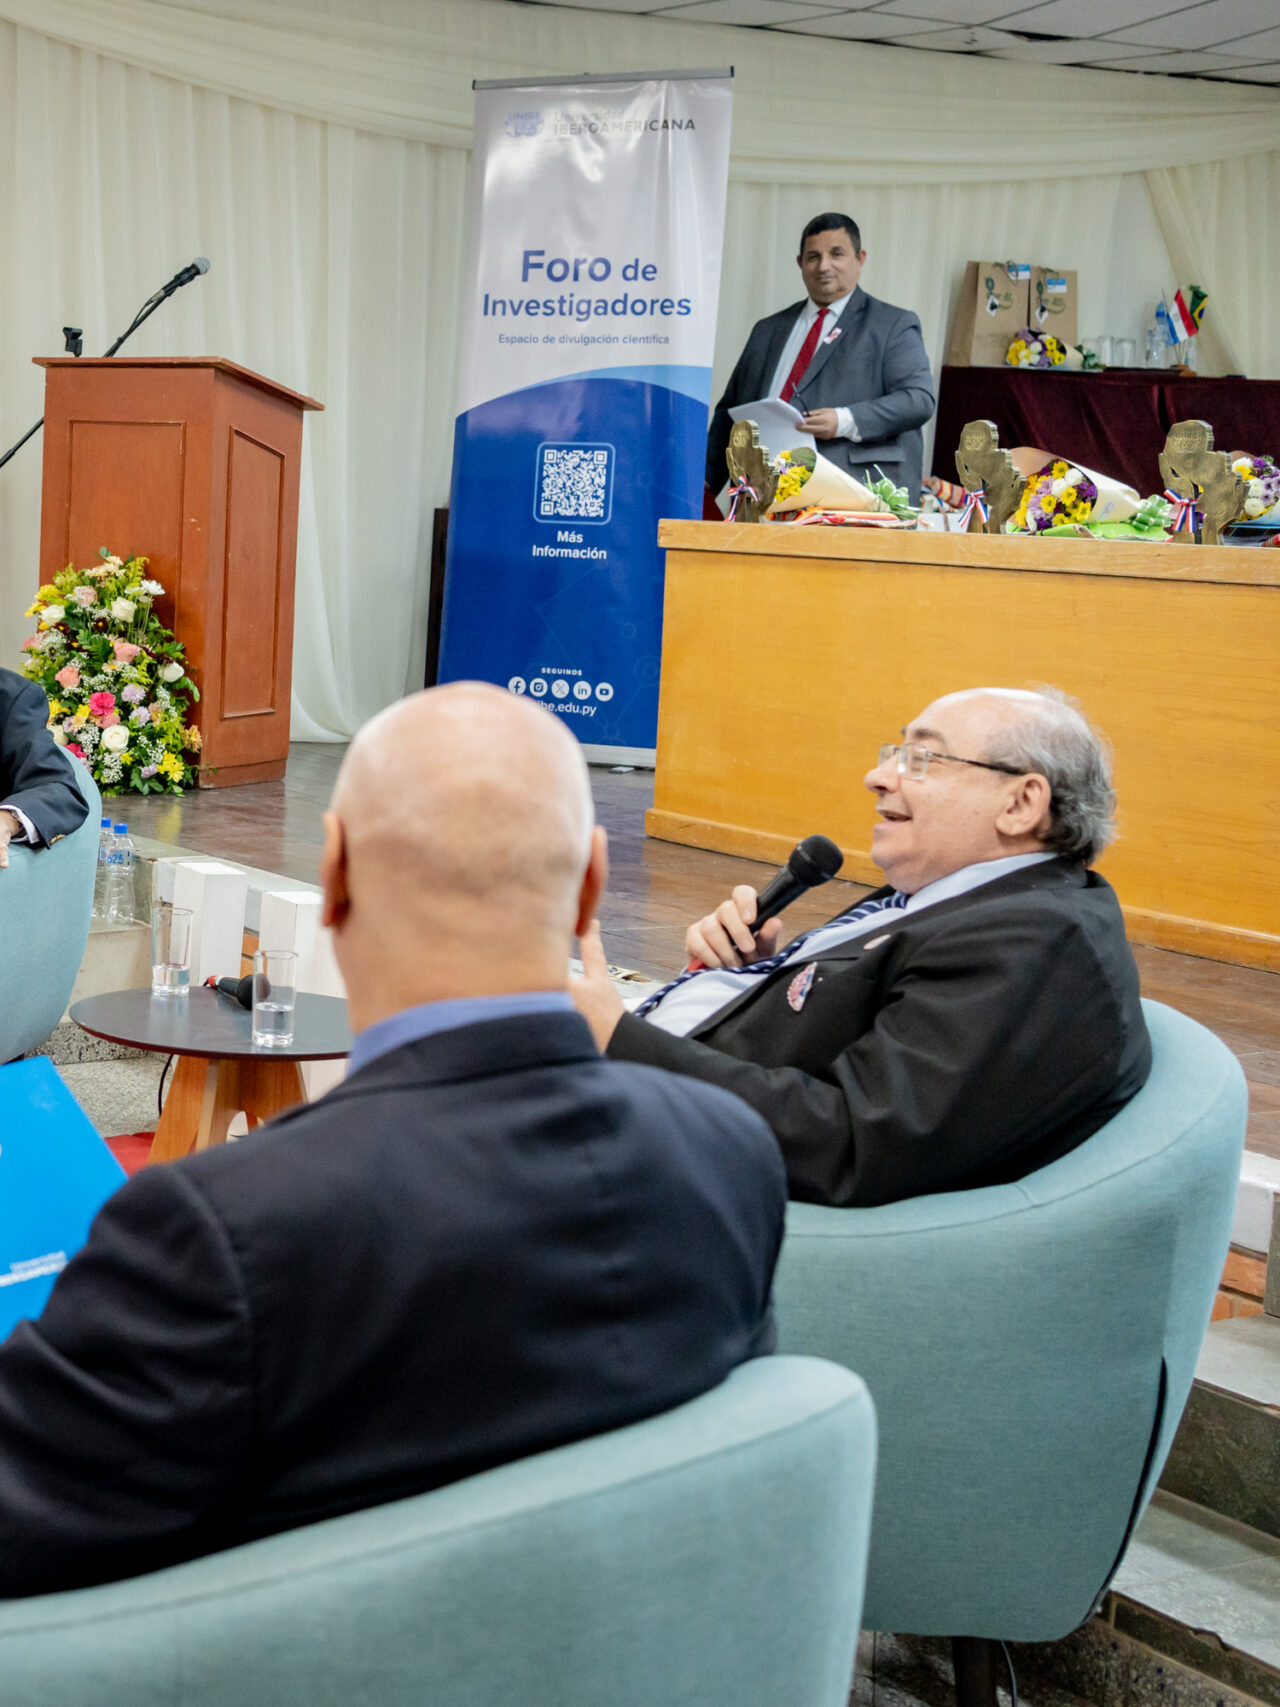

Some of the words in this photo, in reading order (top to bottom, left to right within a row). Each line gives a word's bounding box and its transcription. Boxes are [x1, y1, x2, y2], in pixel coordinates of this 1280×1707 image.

[553, 117, 696, 135] IBEROAMERICANA
[521, 250, 612, 283] Foro
[621, 258, 658, 282] de
[482, 293, 692, 322] Investigadores
[498, 333, 539, 346] Espacio
[542, 333, 556, 344] de
[558, 333, 620, 347] divulgación
[556, 530, 584, 543] Más
[532, 544, 607, 560] Información
[541, 667, 583, 676] SEGUINOS
[537, 700, 597, 717] ibe.edu.py
